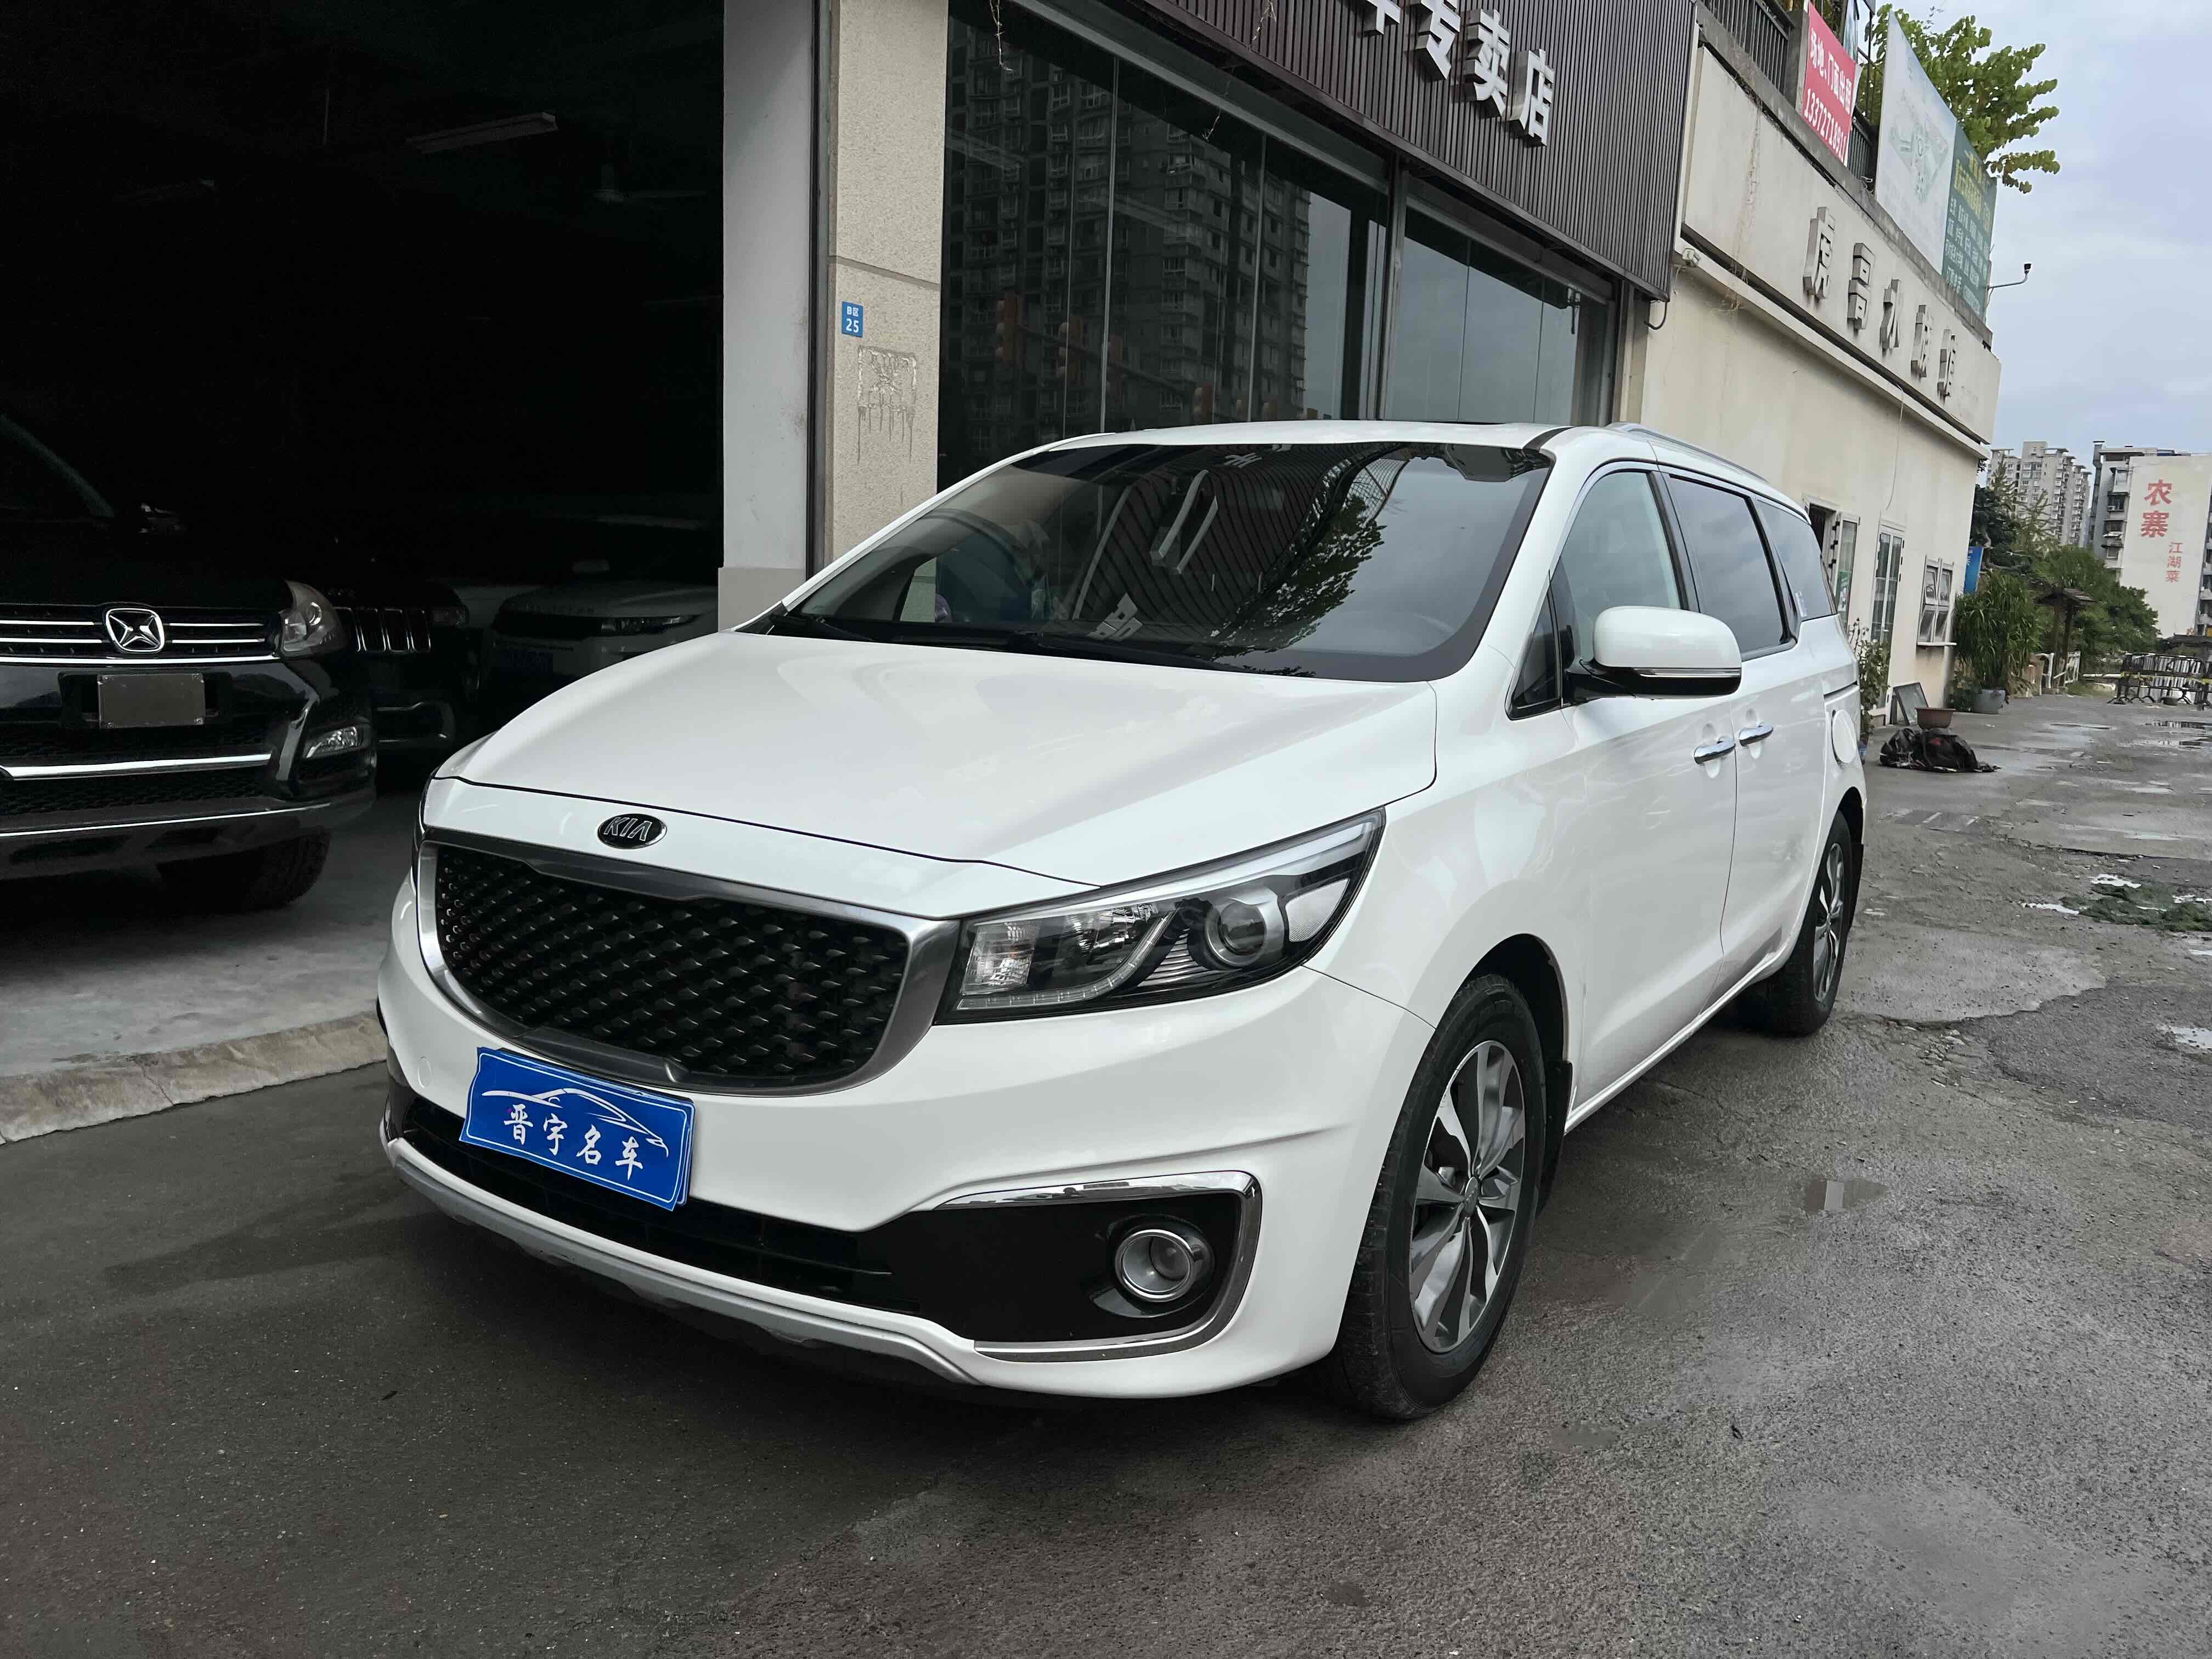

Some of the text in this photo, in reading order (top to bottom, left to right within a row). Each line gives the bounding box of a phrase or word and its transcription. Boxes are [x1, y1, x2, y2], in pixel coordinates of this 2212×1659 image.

[845, 318, 859, 334] 25
[846, 306, 859, 317] B区
[2141, 479, 2172, 538] 农寨
[2165, 541, 2183, 583] 江湖菜
[603, 816, 653, 842] KIA
[503, 1103, 644, 1181] 晋宇名车
